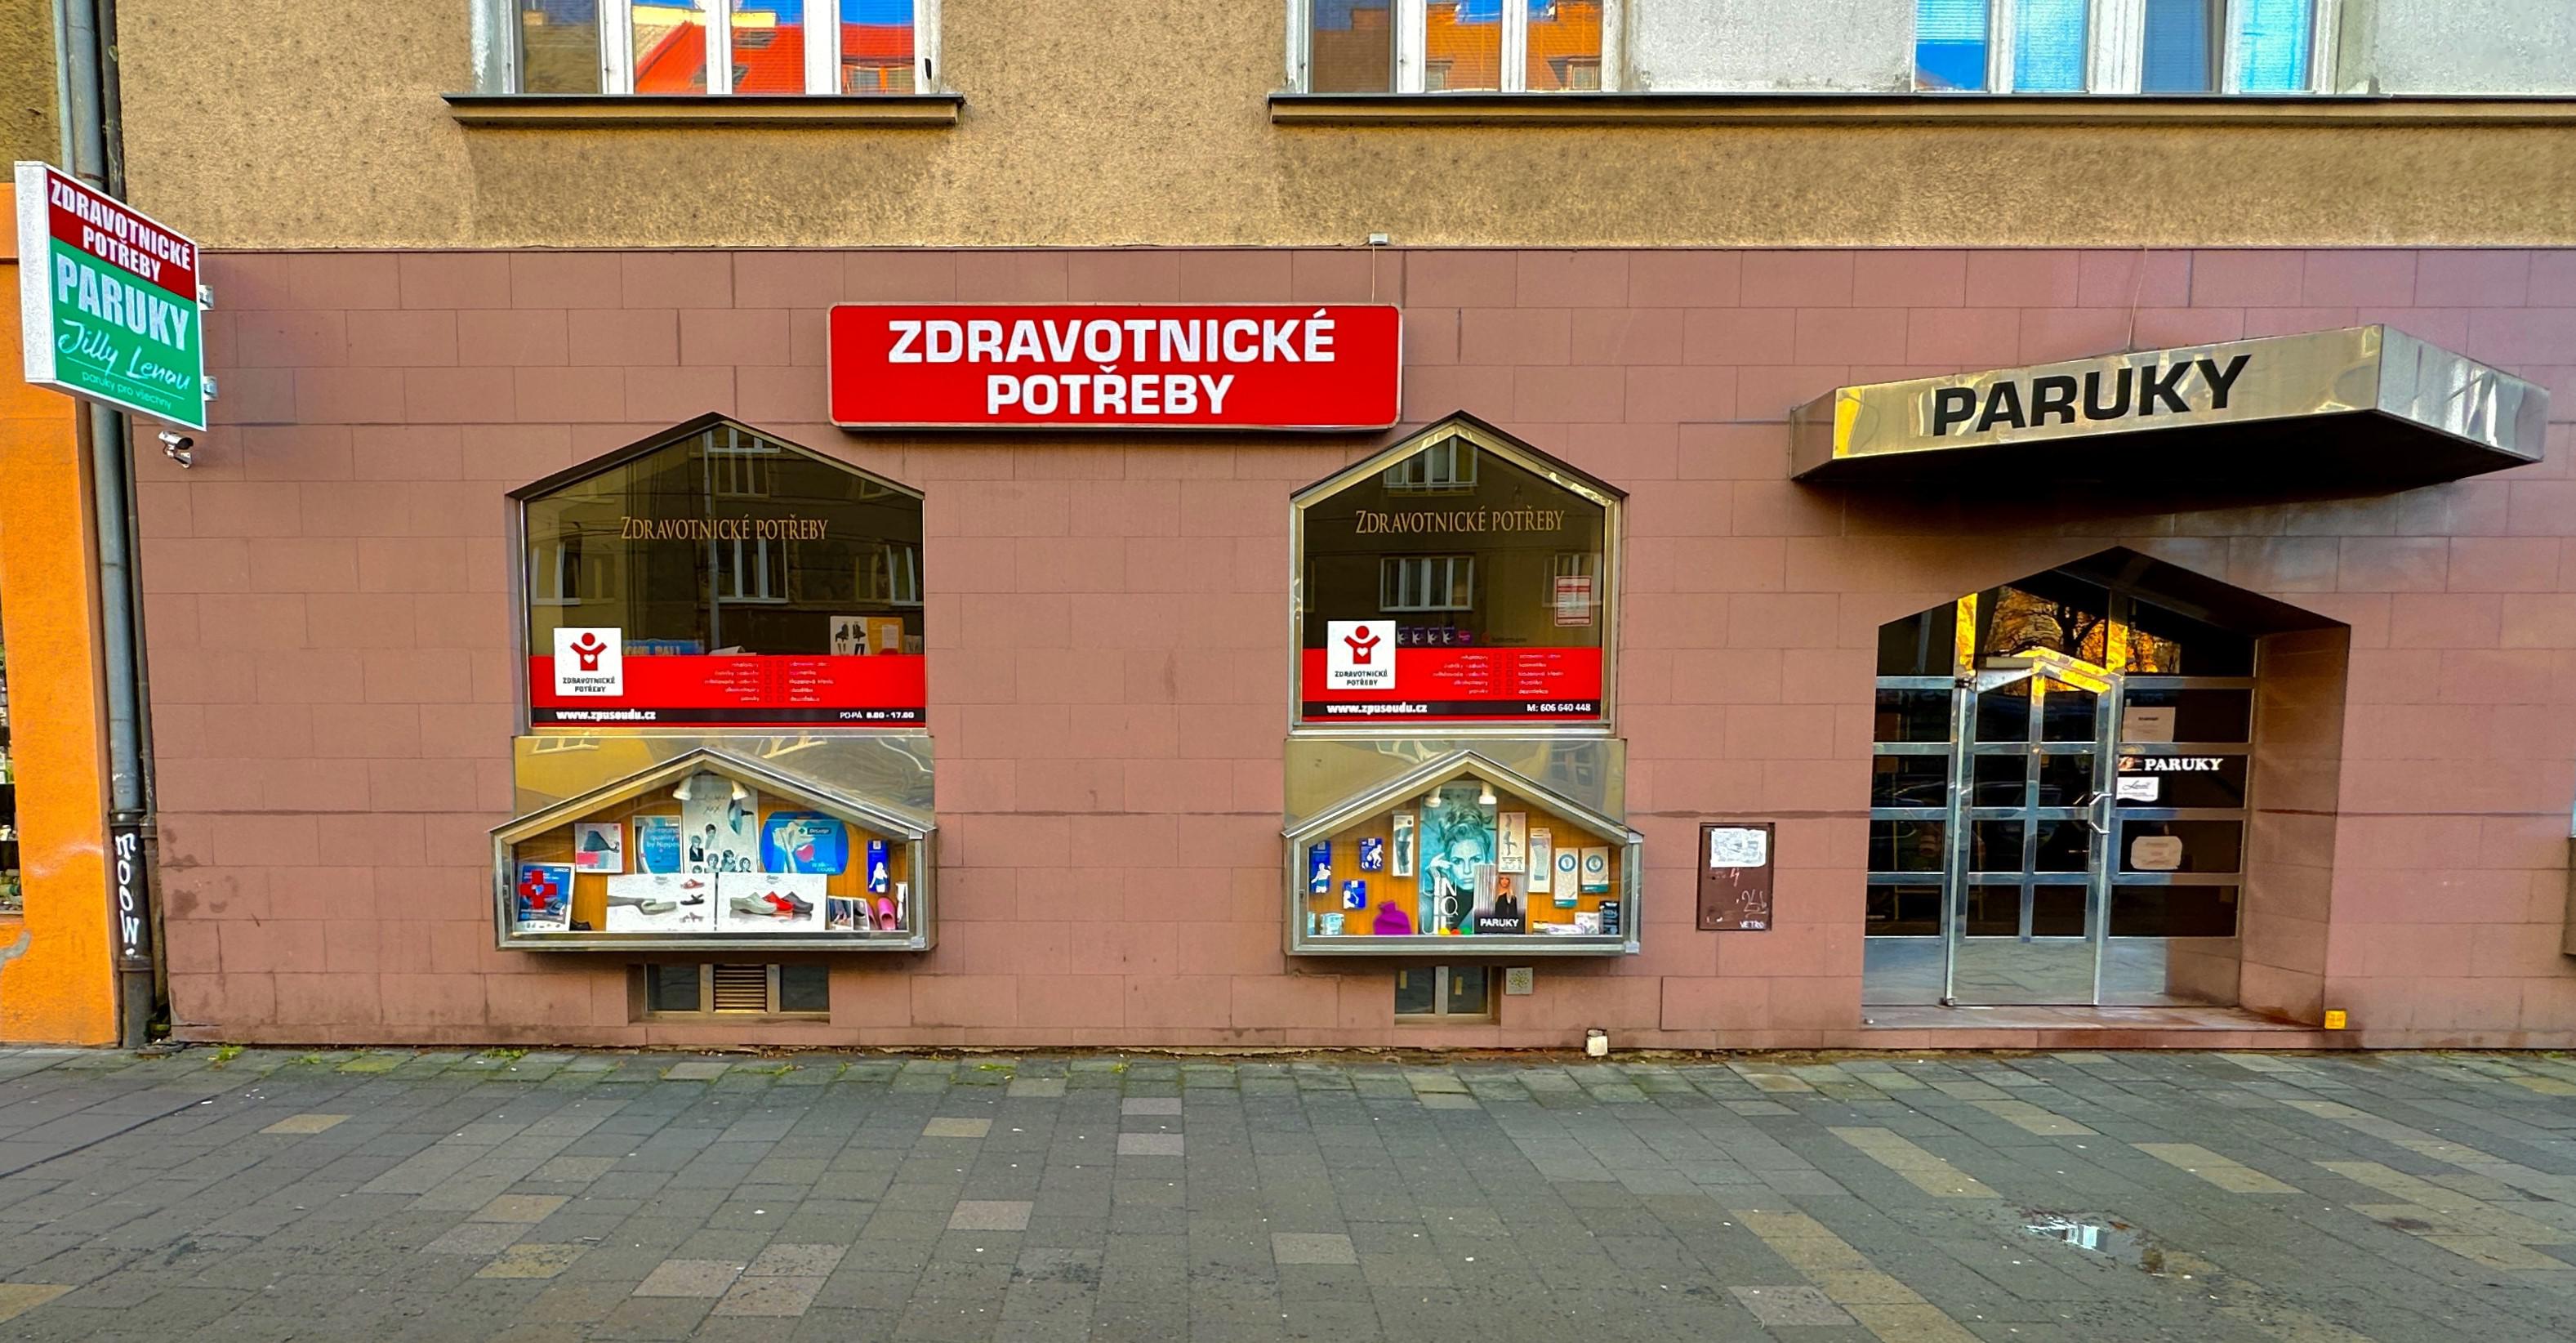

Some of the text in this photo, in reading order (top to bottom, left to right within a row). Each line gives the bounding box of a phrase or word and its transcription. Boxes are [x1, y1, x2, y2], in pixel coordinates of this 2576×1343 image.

[51, 177, 191, 271] ZDRAVOTNICKÉ
[82, 225, 162, 283] POTŘEBY
[56, 252, 190, 352] PARUKY
[888, 307, 1336, 364] ZDRAVOTNICKÉ
[57, 318, 191, 390] Jilly Lenau
[82, 371, 116, 393] paruky
[117, 380, 134, 398] pro
[987, 364, 1236, 416] POTŘEBY
[1932, 353, 2252, 437] PARUKY
[620, 512, 829, 541] ZDRAVOTNICKÉ POTŘEBY
[1355, 504, 1565, 534] ZDRAVOTNICKÉ POTŘEBY
[562, 676, 616, 684] ZDRAVOTNICKÉ
[1335, 668, 1388, 677] ZDRAVOTNICKÉ
[1346, 677, 1378, 686] POTŘEBY
[574, 684, 606, 693] POTŘEBY
[555, 708, 657, 721] www.zpusoudu.cz
[1326, 702, 1428, 715] www.zpusoudu.cz
[1526, 703, 1591, 712] M: 606 640 448
[2144, 757, 2224, 771] PARUKY
[1480, 917, 1519, 927] PARUKY
